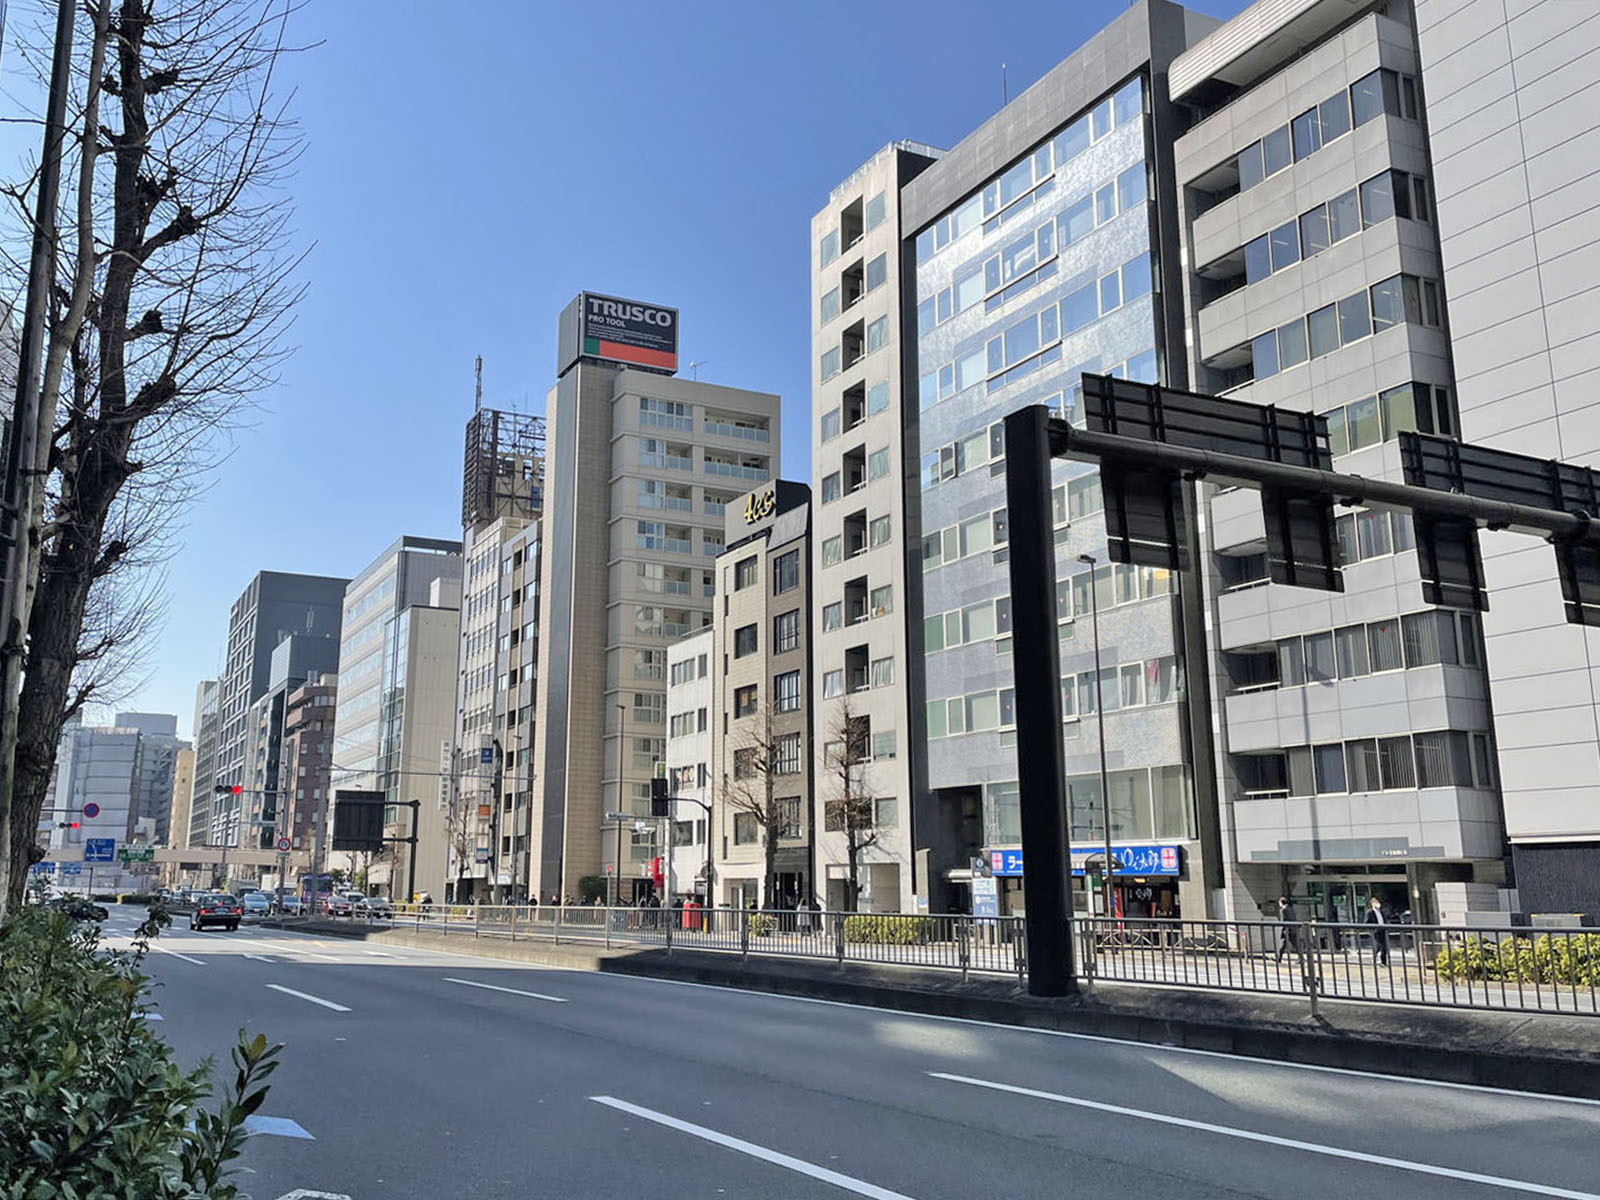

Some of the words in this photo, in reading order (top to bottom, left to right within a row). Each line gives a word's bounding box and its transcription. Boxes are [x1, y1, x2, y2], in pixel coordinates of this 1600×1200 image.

[588, 298, 672, 327] TRUSCO
[588, 314, 604, 323] PRO
[605, 317, 626, 328] TOOL
